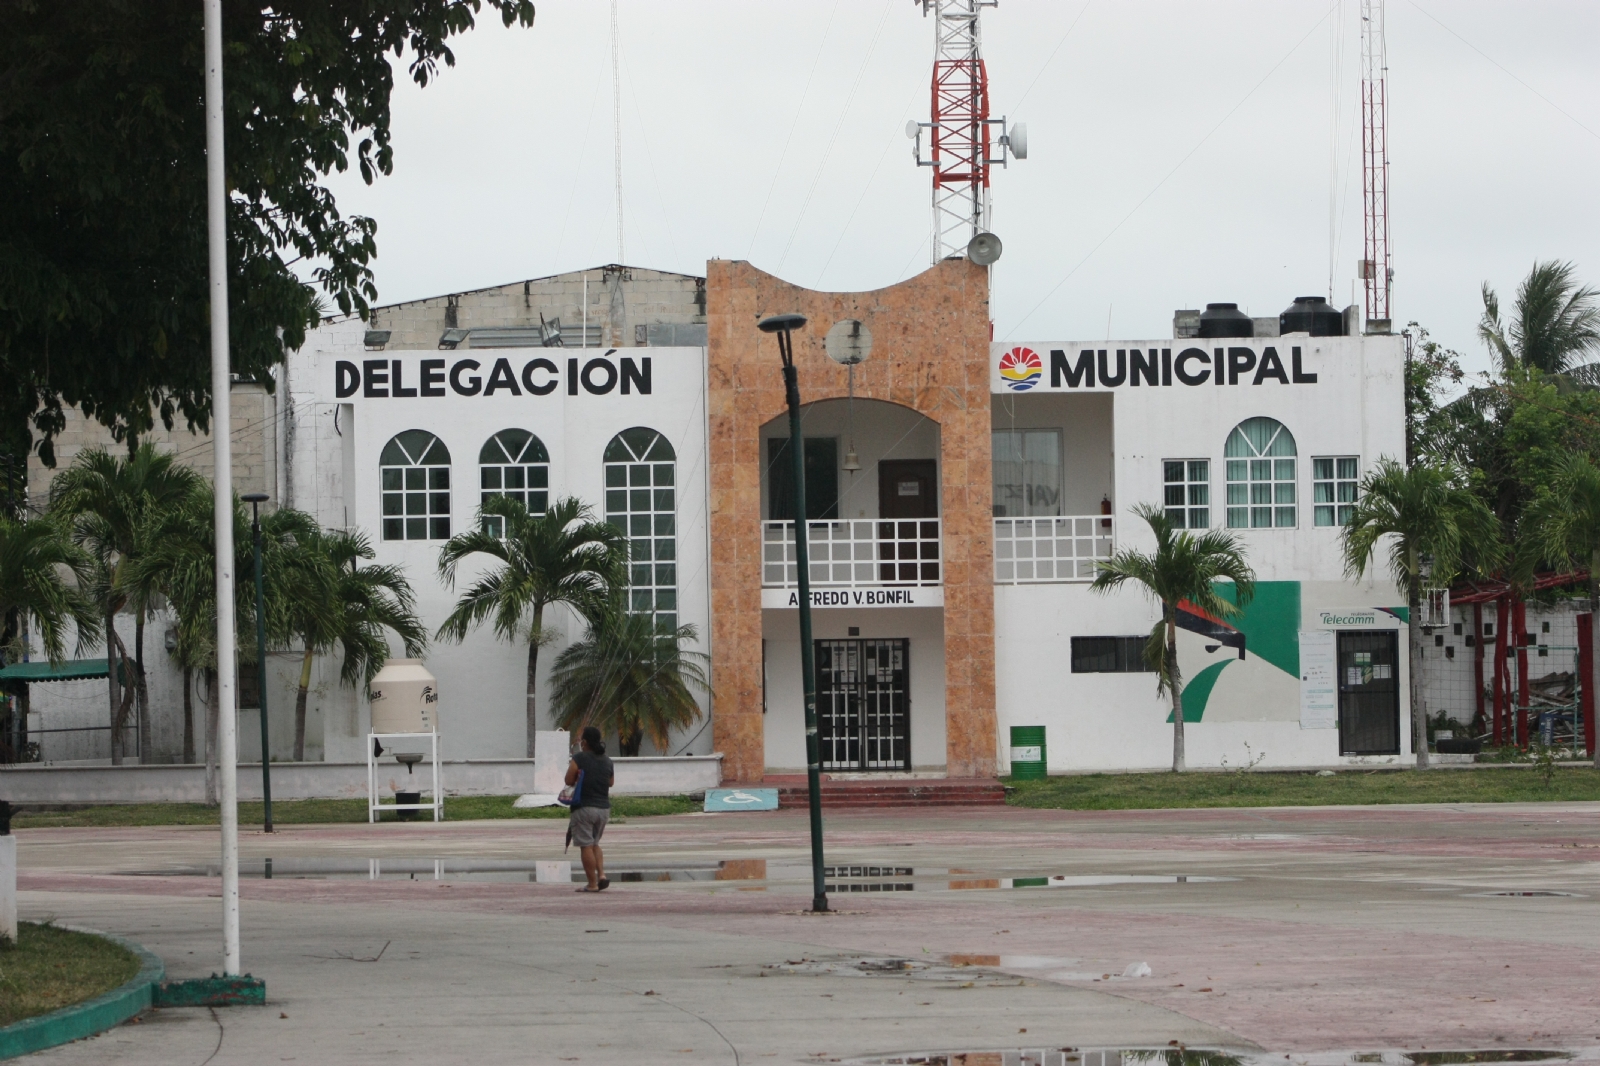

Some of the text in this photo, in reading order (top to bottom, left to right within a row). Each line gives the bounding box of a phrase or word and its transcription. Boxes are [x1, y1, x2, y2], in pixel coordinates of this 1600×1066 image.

[335, 349, 652, 398] DELEGACIÓN
[1050, 346, 1318, 388] MUNICIPAL
[788, 591, 849, 606] AFREDO
[866, 590, 915, 605] BONFIL
[1320, 612, 1375, 625] Telecomm
